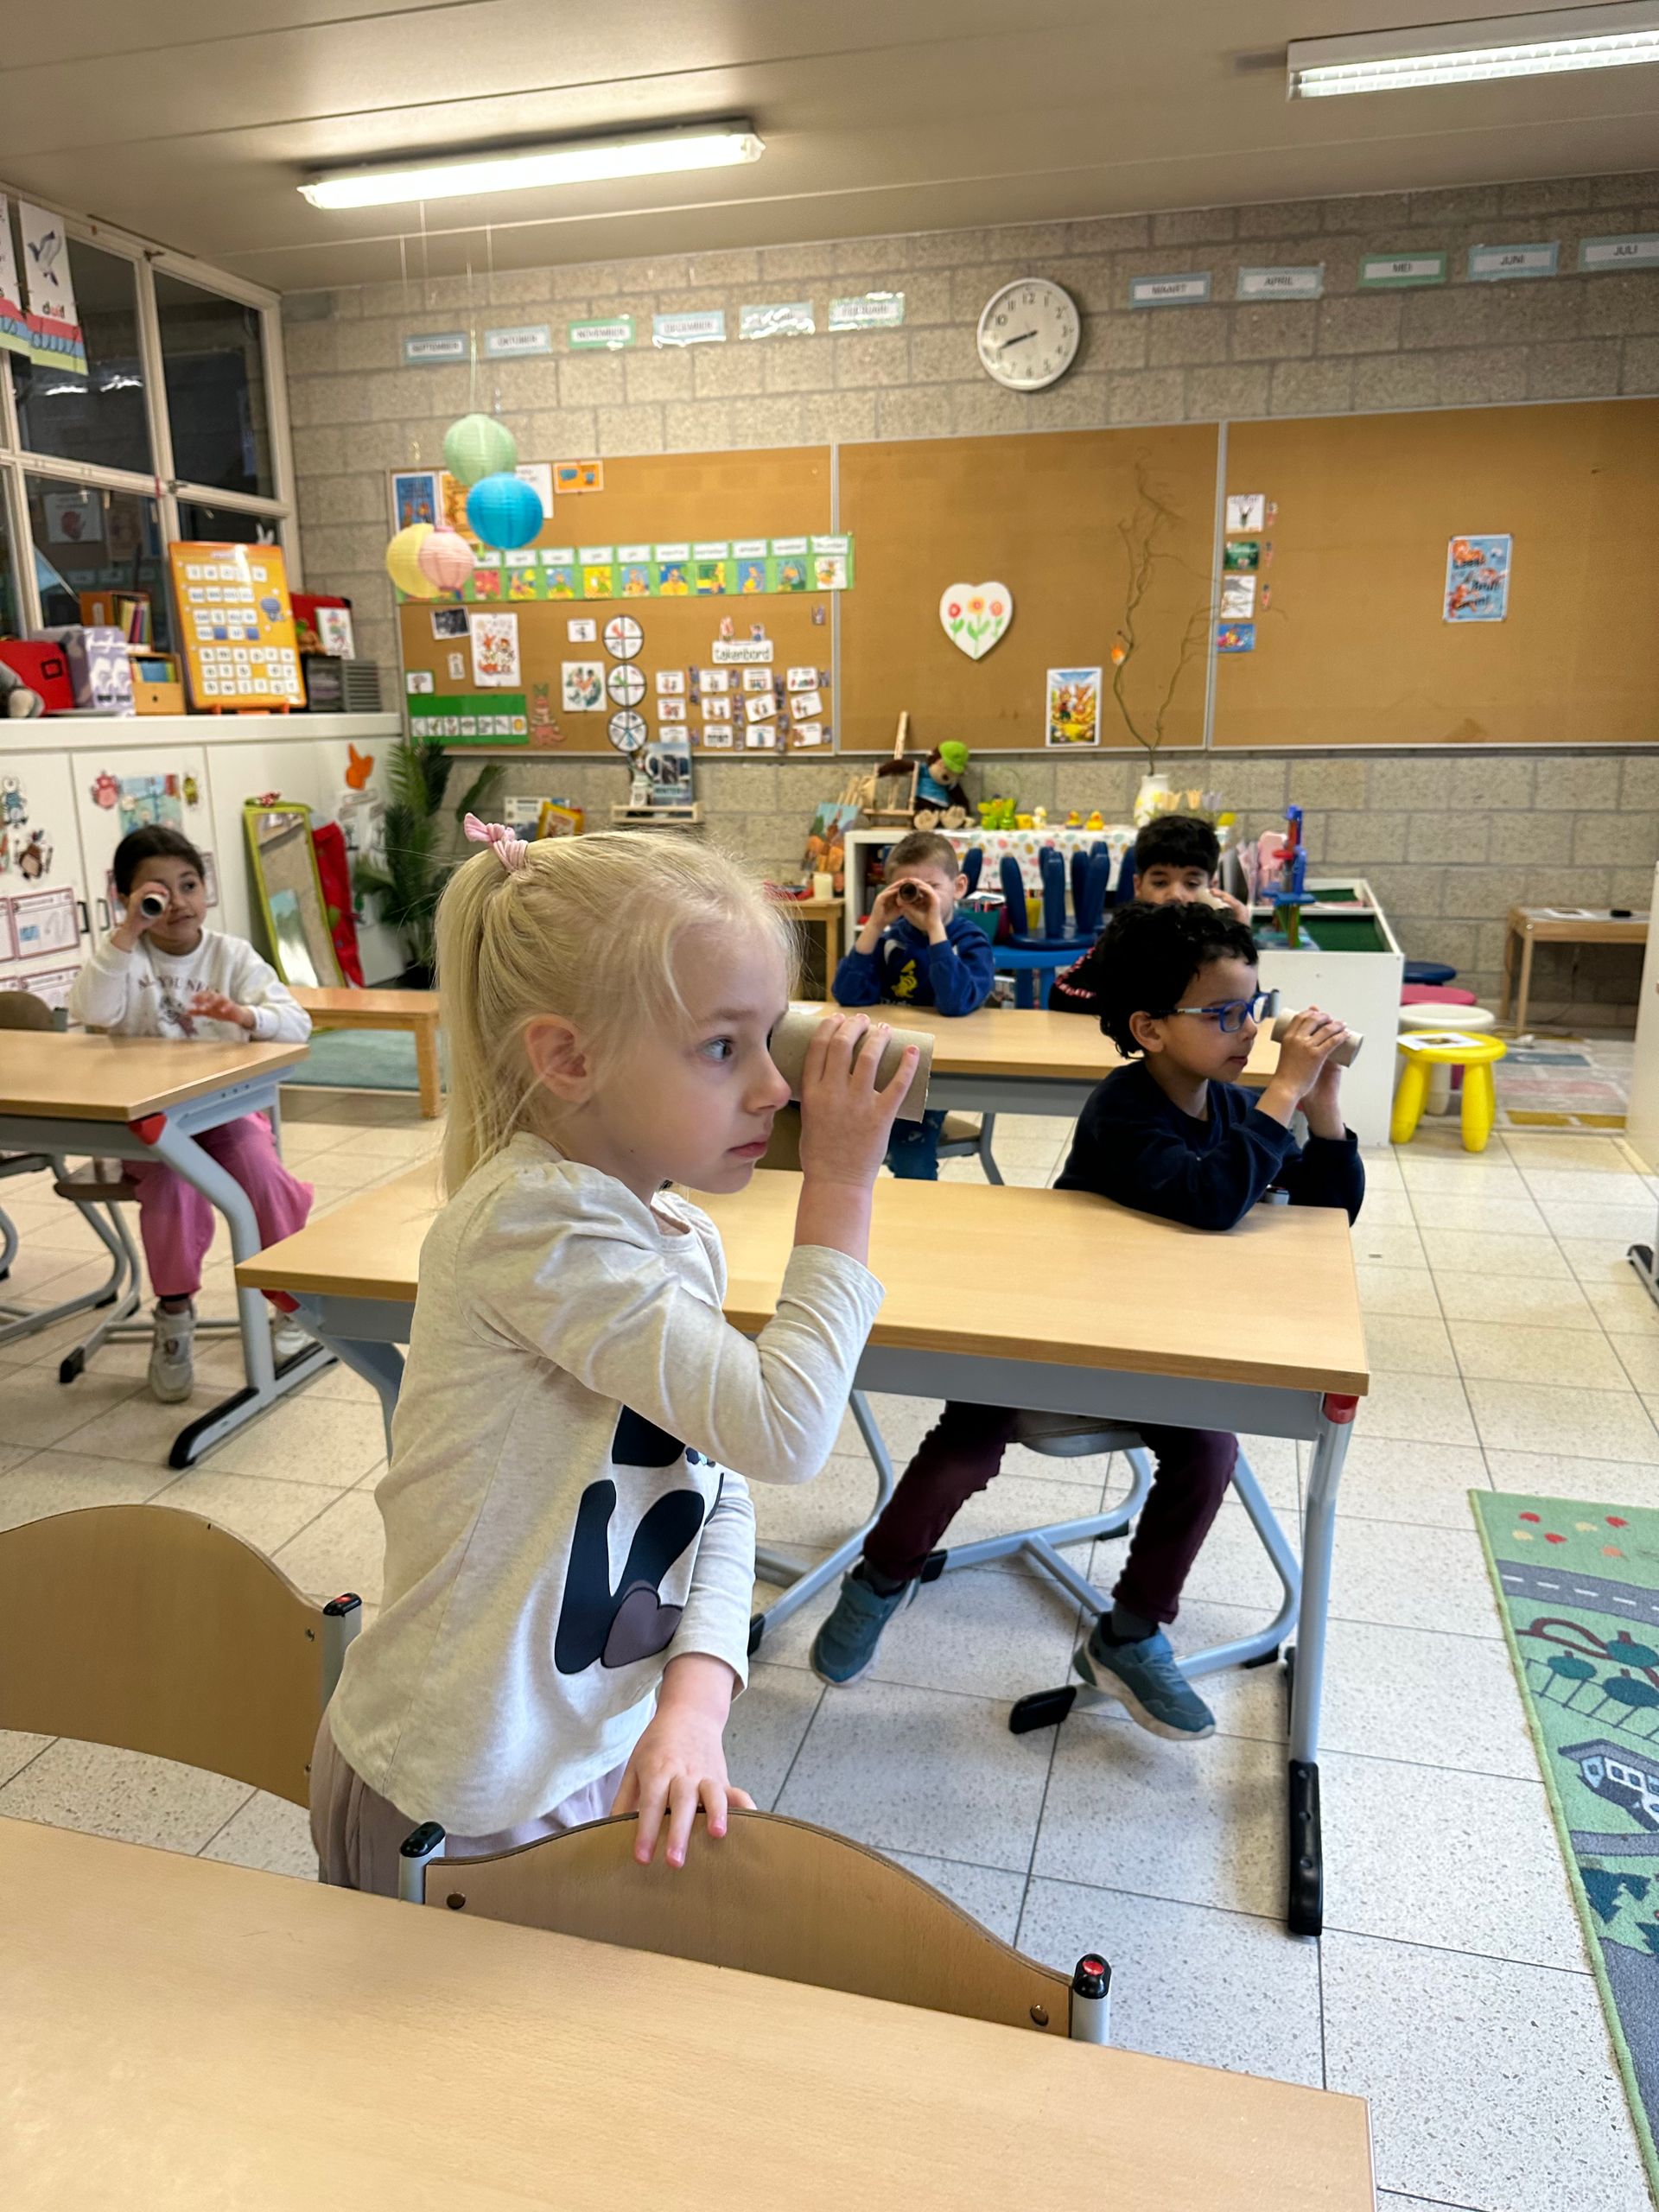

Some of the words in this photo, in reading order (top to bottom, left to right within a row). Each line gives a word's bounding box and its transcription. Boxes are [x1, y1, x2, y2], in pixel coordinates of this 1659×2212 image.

[1612, 245, 1638, 257] JULI
[1499, 253, 1525, 266] JUNI
[1263, 276, 1294, 287] APRIL
[1022, 292, 1036, 303] 12
